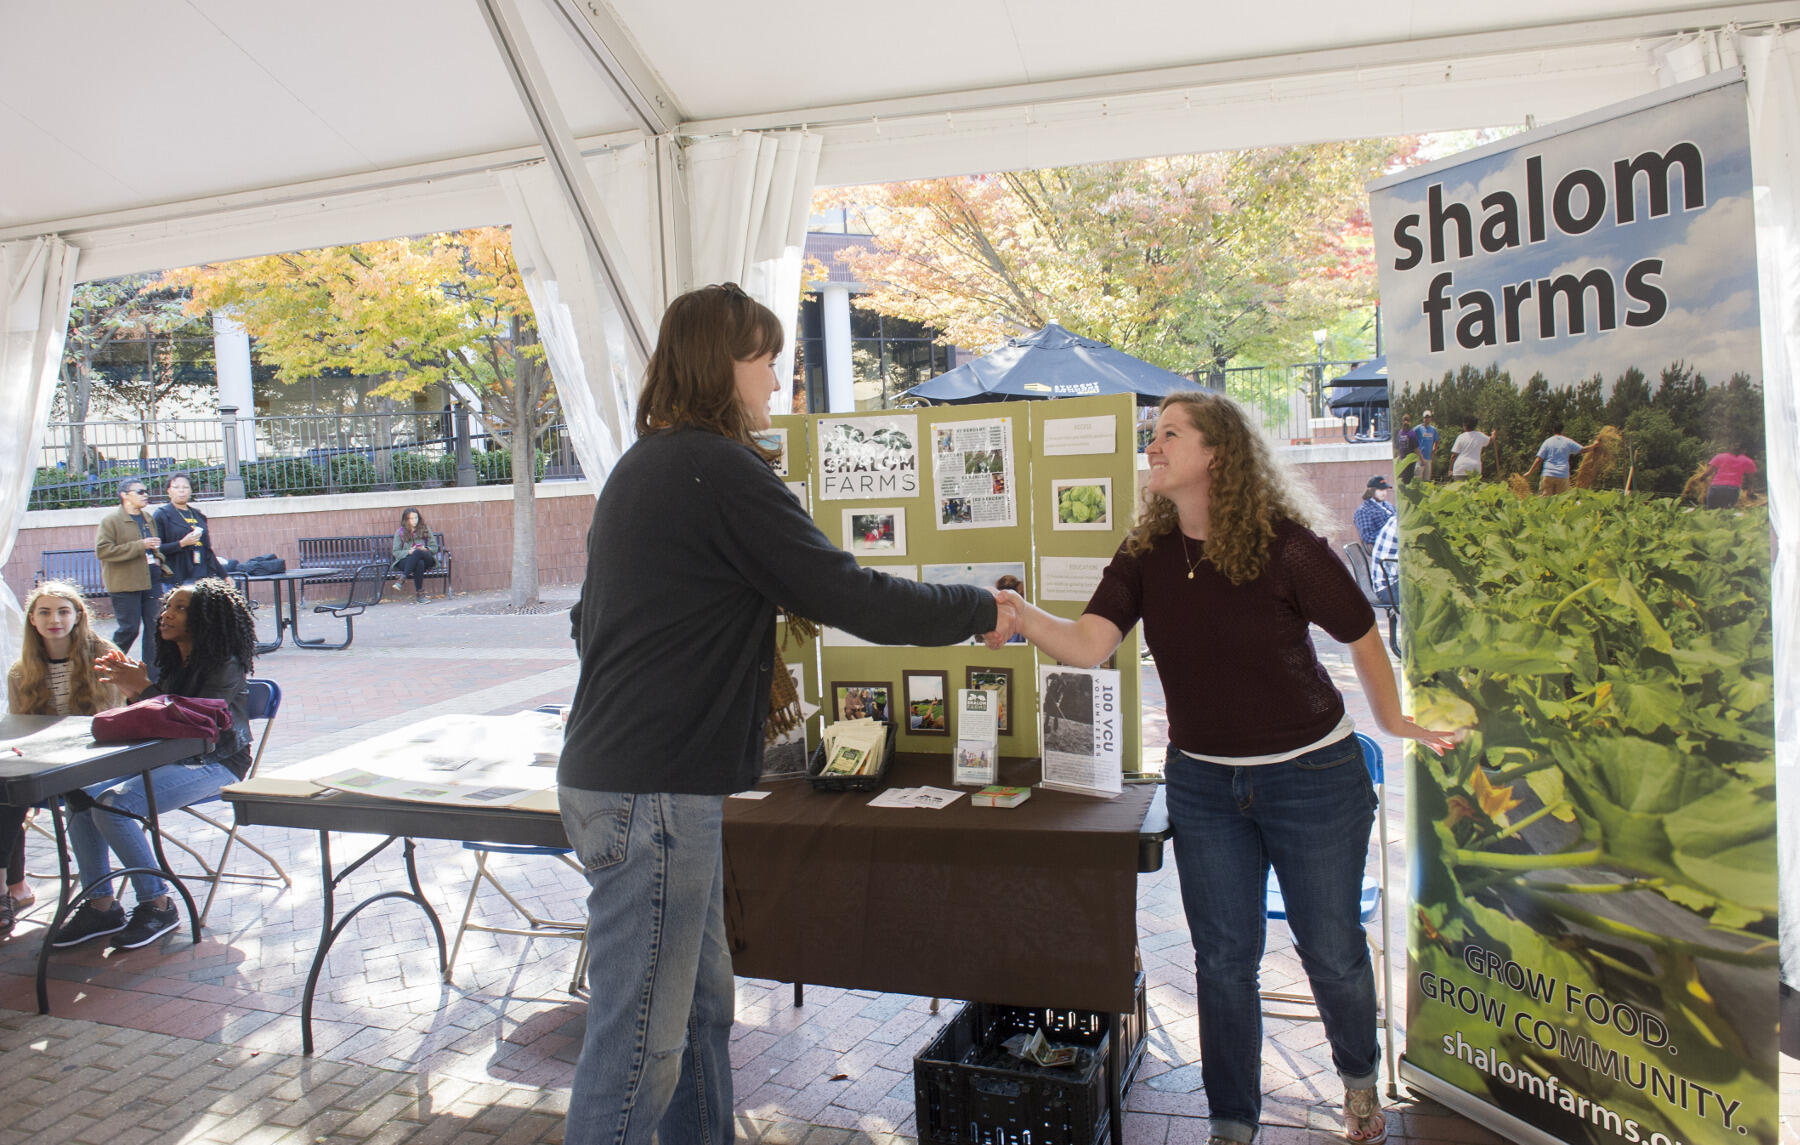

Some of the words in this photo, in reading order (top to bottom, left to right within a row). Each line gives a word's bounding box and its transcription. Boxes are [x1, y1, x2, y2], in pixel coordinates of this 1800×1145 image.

[1393, 140, 1704, 271] shalom
[1423, 258, 1668, 353] farms
[823, 454, 915, 473] SHALOM
[824, 473, 916, 494] FARMS
[1103, 719, 1114, 752] VCU
[1464, 944, 1556, 1005] GROW
[1565, 982, 1678, 1056] FOOD.
[1418, 971, 1506, 1028] GROW
[1514, 1011, 1748, 1136] COMMUNITY.
